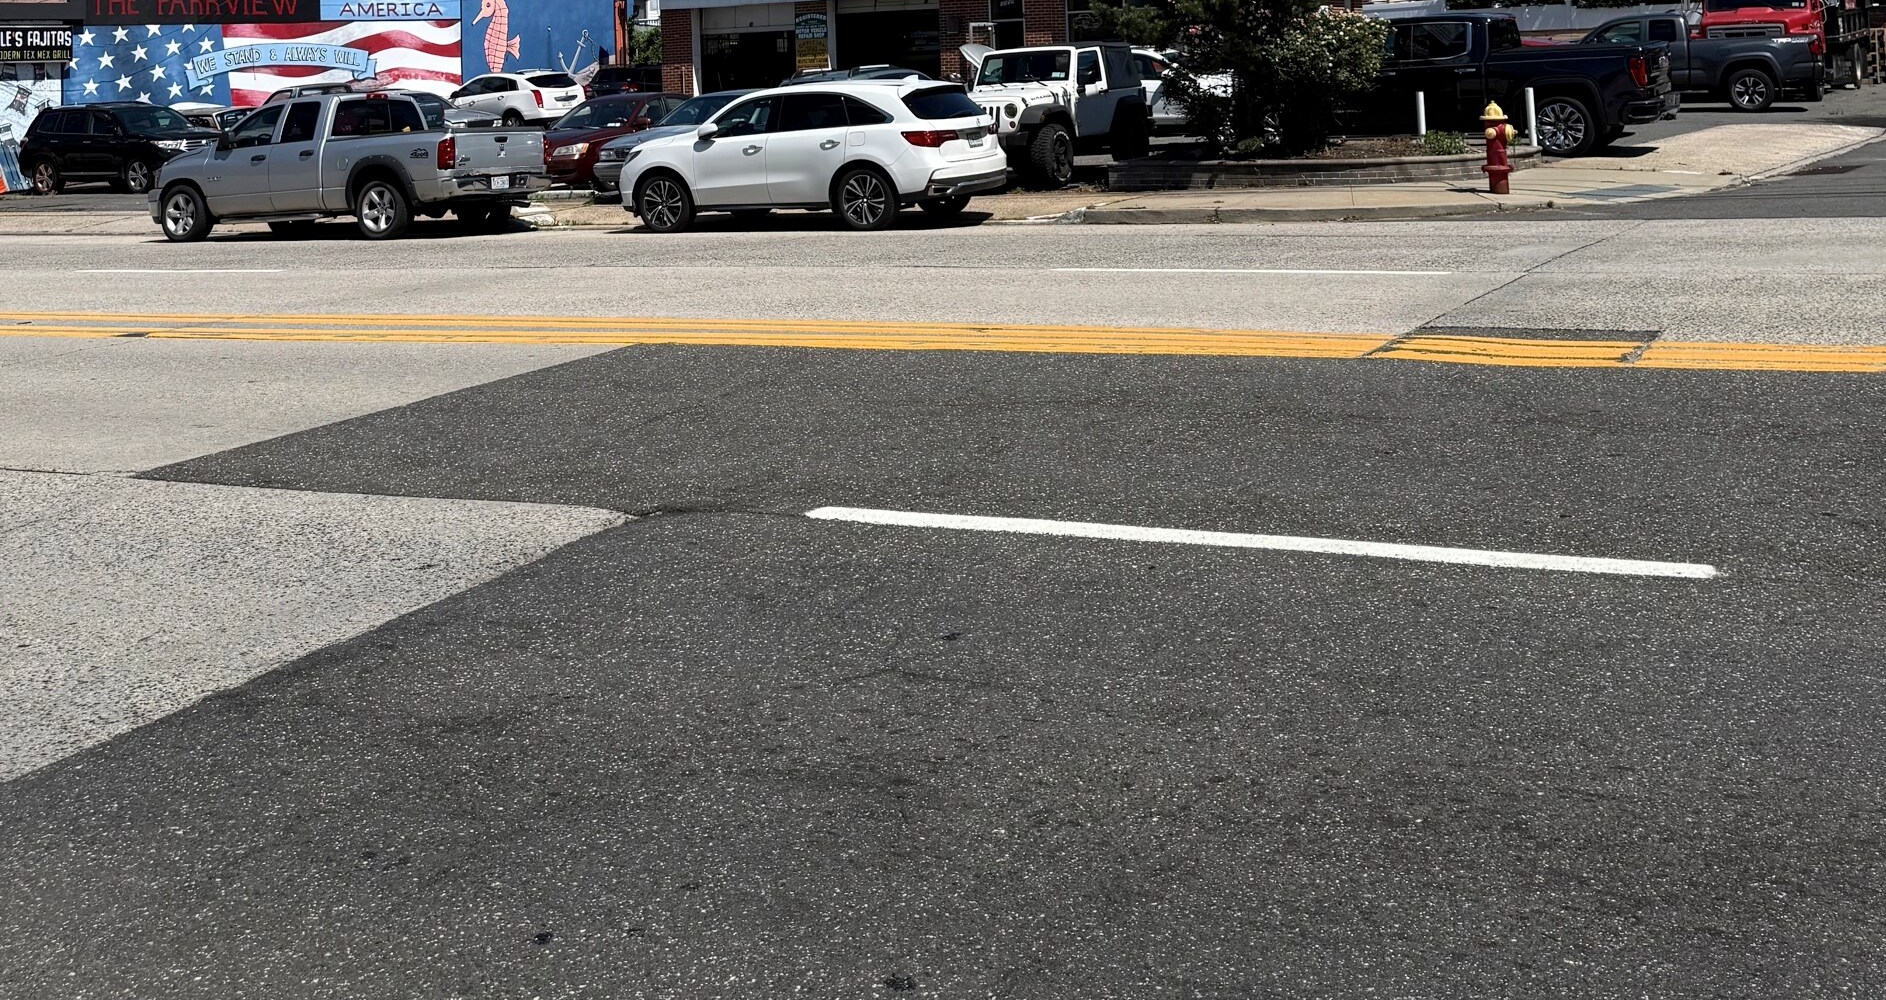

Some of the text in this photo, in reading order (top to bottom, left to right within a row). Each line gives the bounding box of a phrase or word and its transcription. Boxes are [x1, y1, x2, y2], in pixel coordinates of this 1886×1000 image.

[339, 2, 443, 17] AMERICA
[0, 30, 72, 47] LE'S FAJITAS
[23, 50, 36, 60] TEX
[37, 50, 51, 59] MEX
[52, 50, 71, 59] GRILL
[196, 47, 361, 74] WE STAND & ALWAYS WILL
